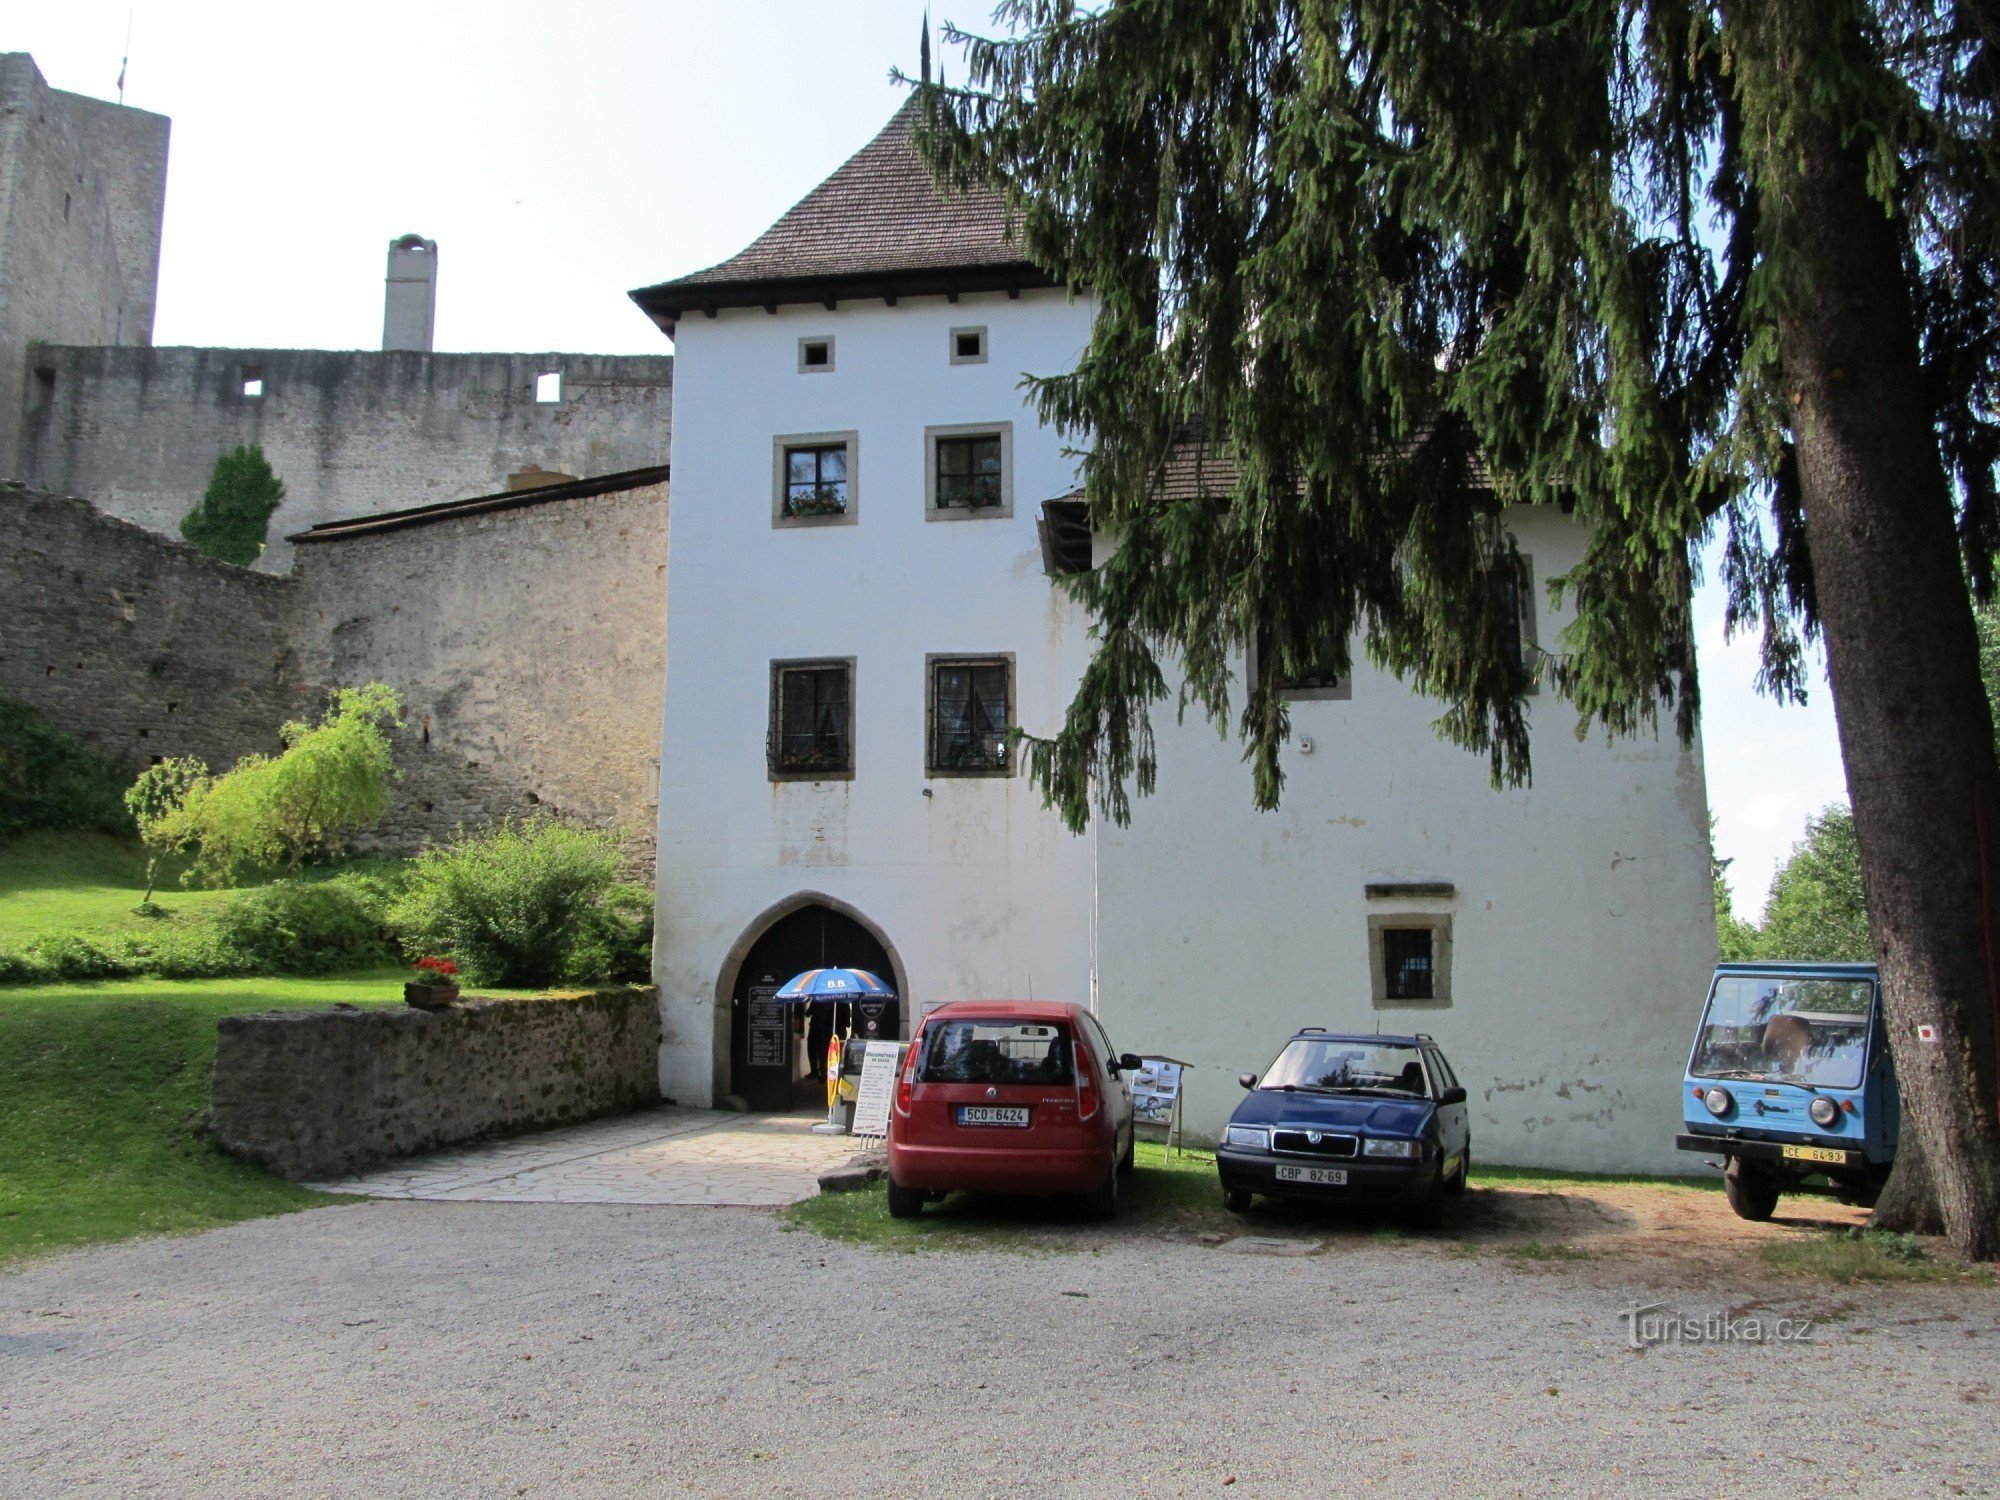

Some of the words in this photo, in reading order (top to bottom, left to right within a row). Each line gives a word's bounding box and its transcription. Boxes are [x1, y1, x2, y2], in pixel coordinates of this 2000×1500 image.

[827, 980, 847, 988] B.B.
[996, 1109, 1023, 1121] 6424
[1788, 1148, 1800, 1157] CE
[1281, 1167, 1301, 1179] CBP
